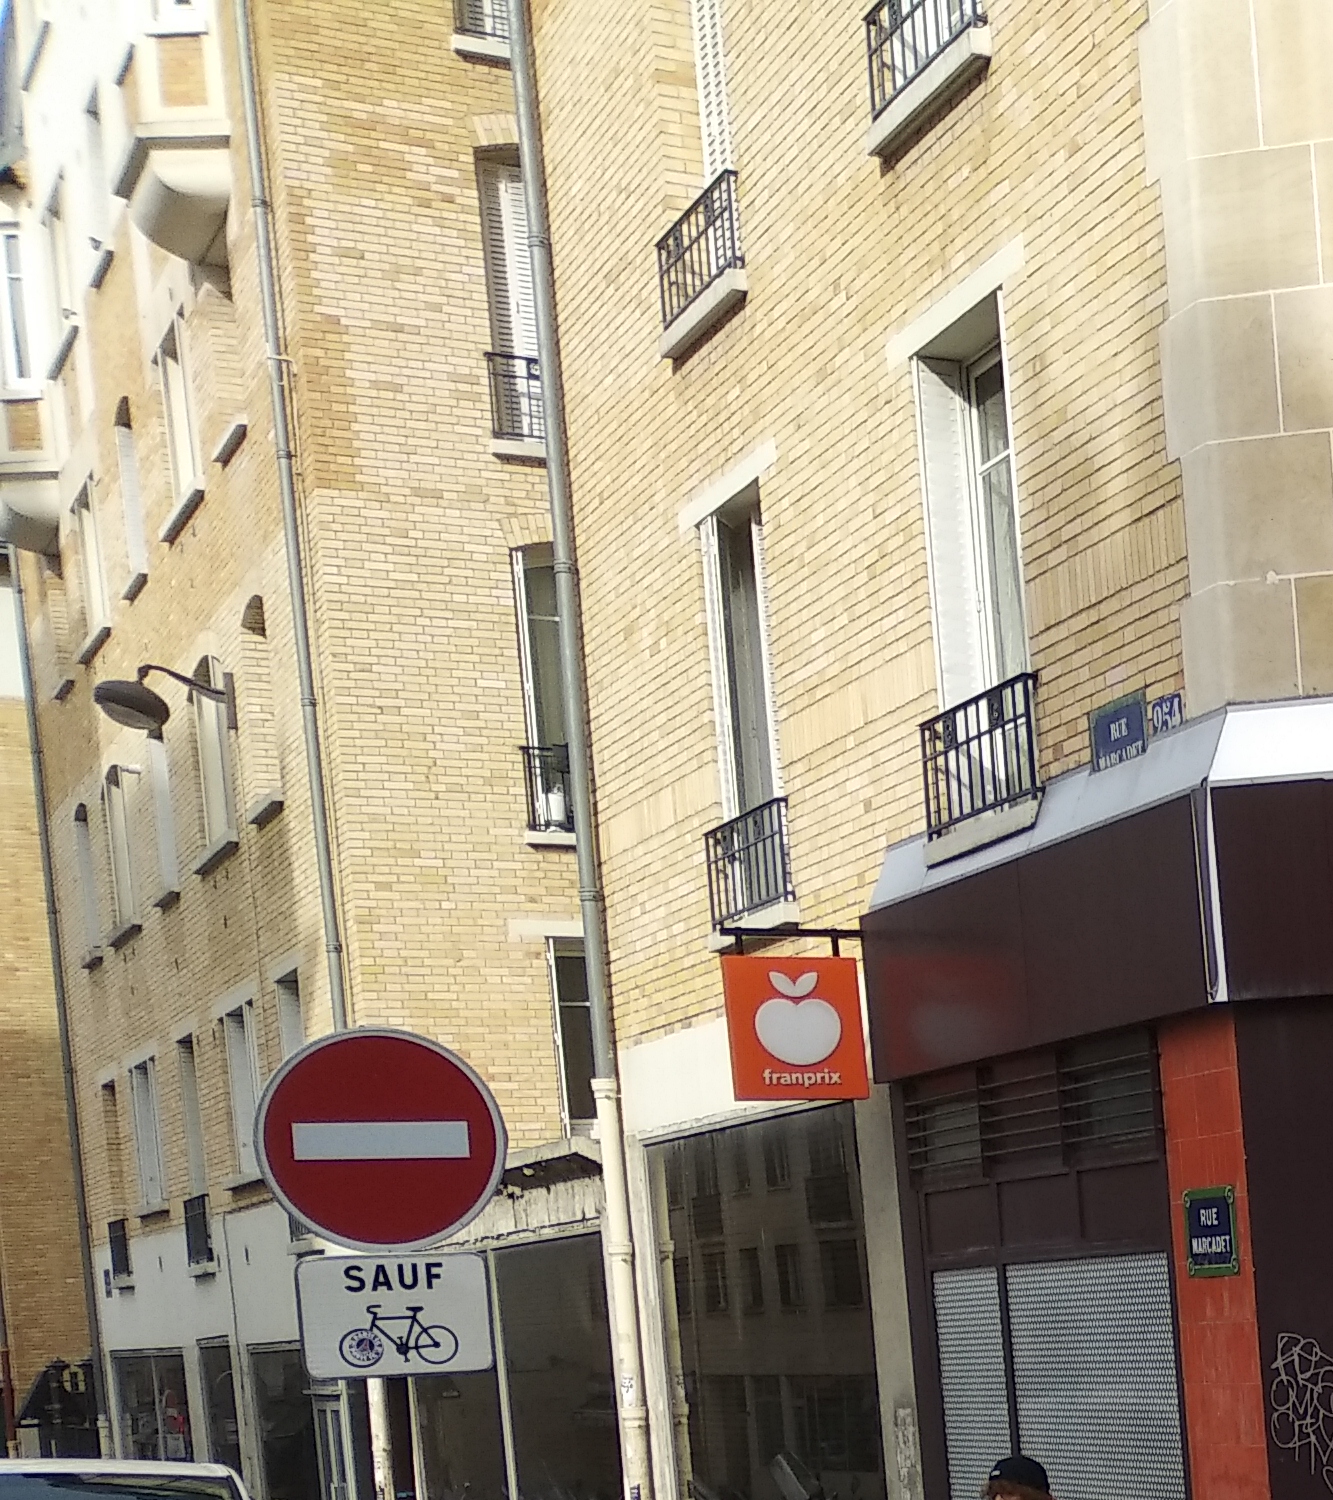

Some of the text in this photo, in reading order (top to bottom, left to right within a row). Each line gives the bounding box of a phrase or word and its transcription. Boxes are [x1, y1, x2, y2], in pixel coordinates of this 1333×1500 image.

[1110, 717, 1128, 741] RUE
[1099, 741, 1143, 770] MARCADET
[763, 1068, 842, 1089] franprix
[1200, 1208, 1218, 1226] RUE
[1192, 1235, 1230, 1254] MARCADET
[343, 1262, 443, 1293] SAUF
